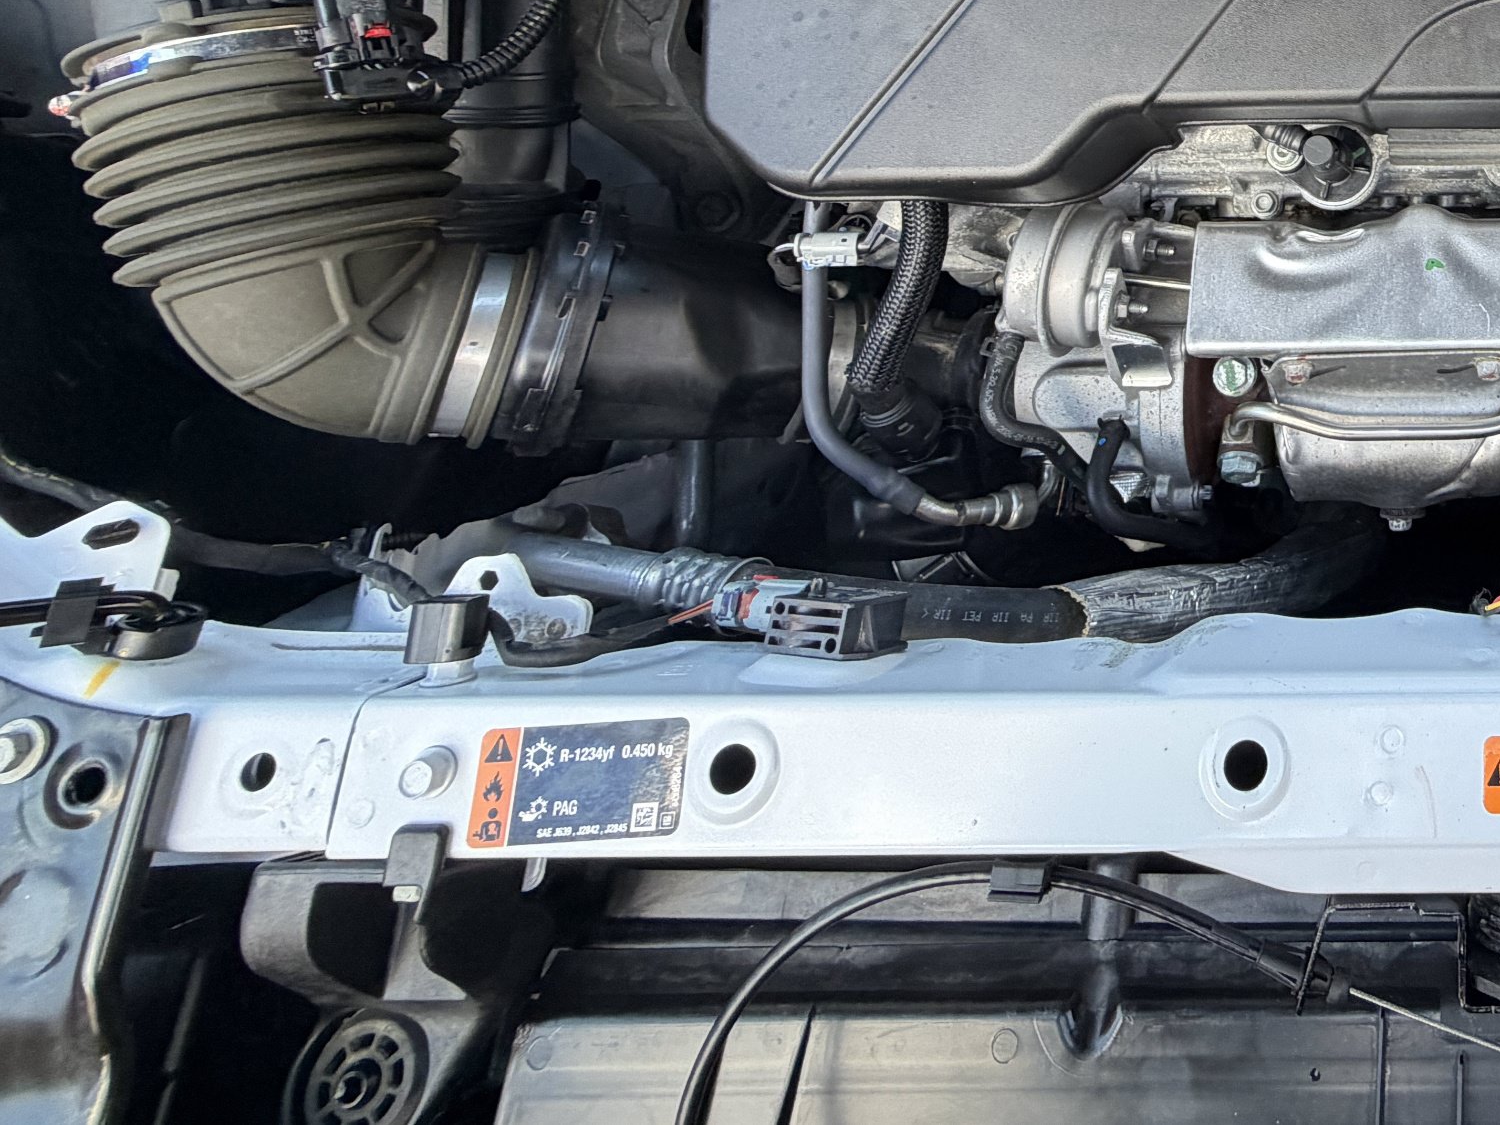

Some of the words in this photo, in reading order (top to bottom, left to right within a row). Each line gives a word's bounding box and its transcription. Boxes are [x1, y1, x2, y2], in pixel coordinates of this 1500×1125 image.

[559, 746, 615, 765] R-1234yf
[621, 743, 656, 759] 0.450
[657, 742, 674, 759] kg
[552, 800, 578, 816] PAG
[536, 828, 553, 839] SAE
